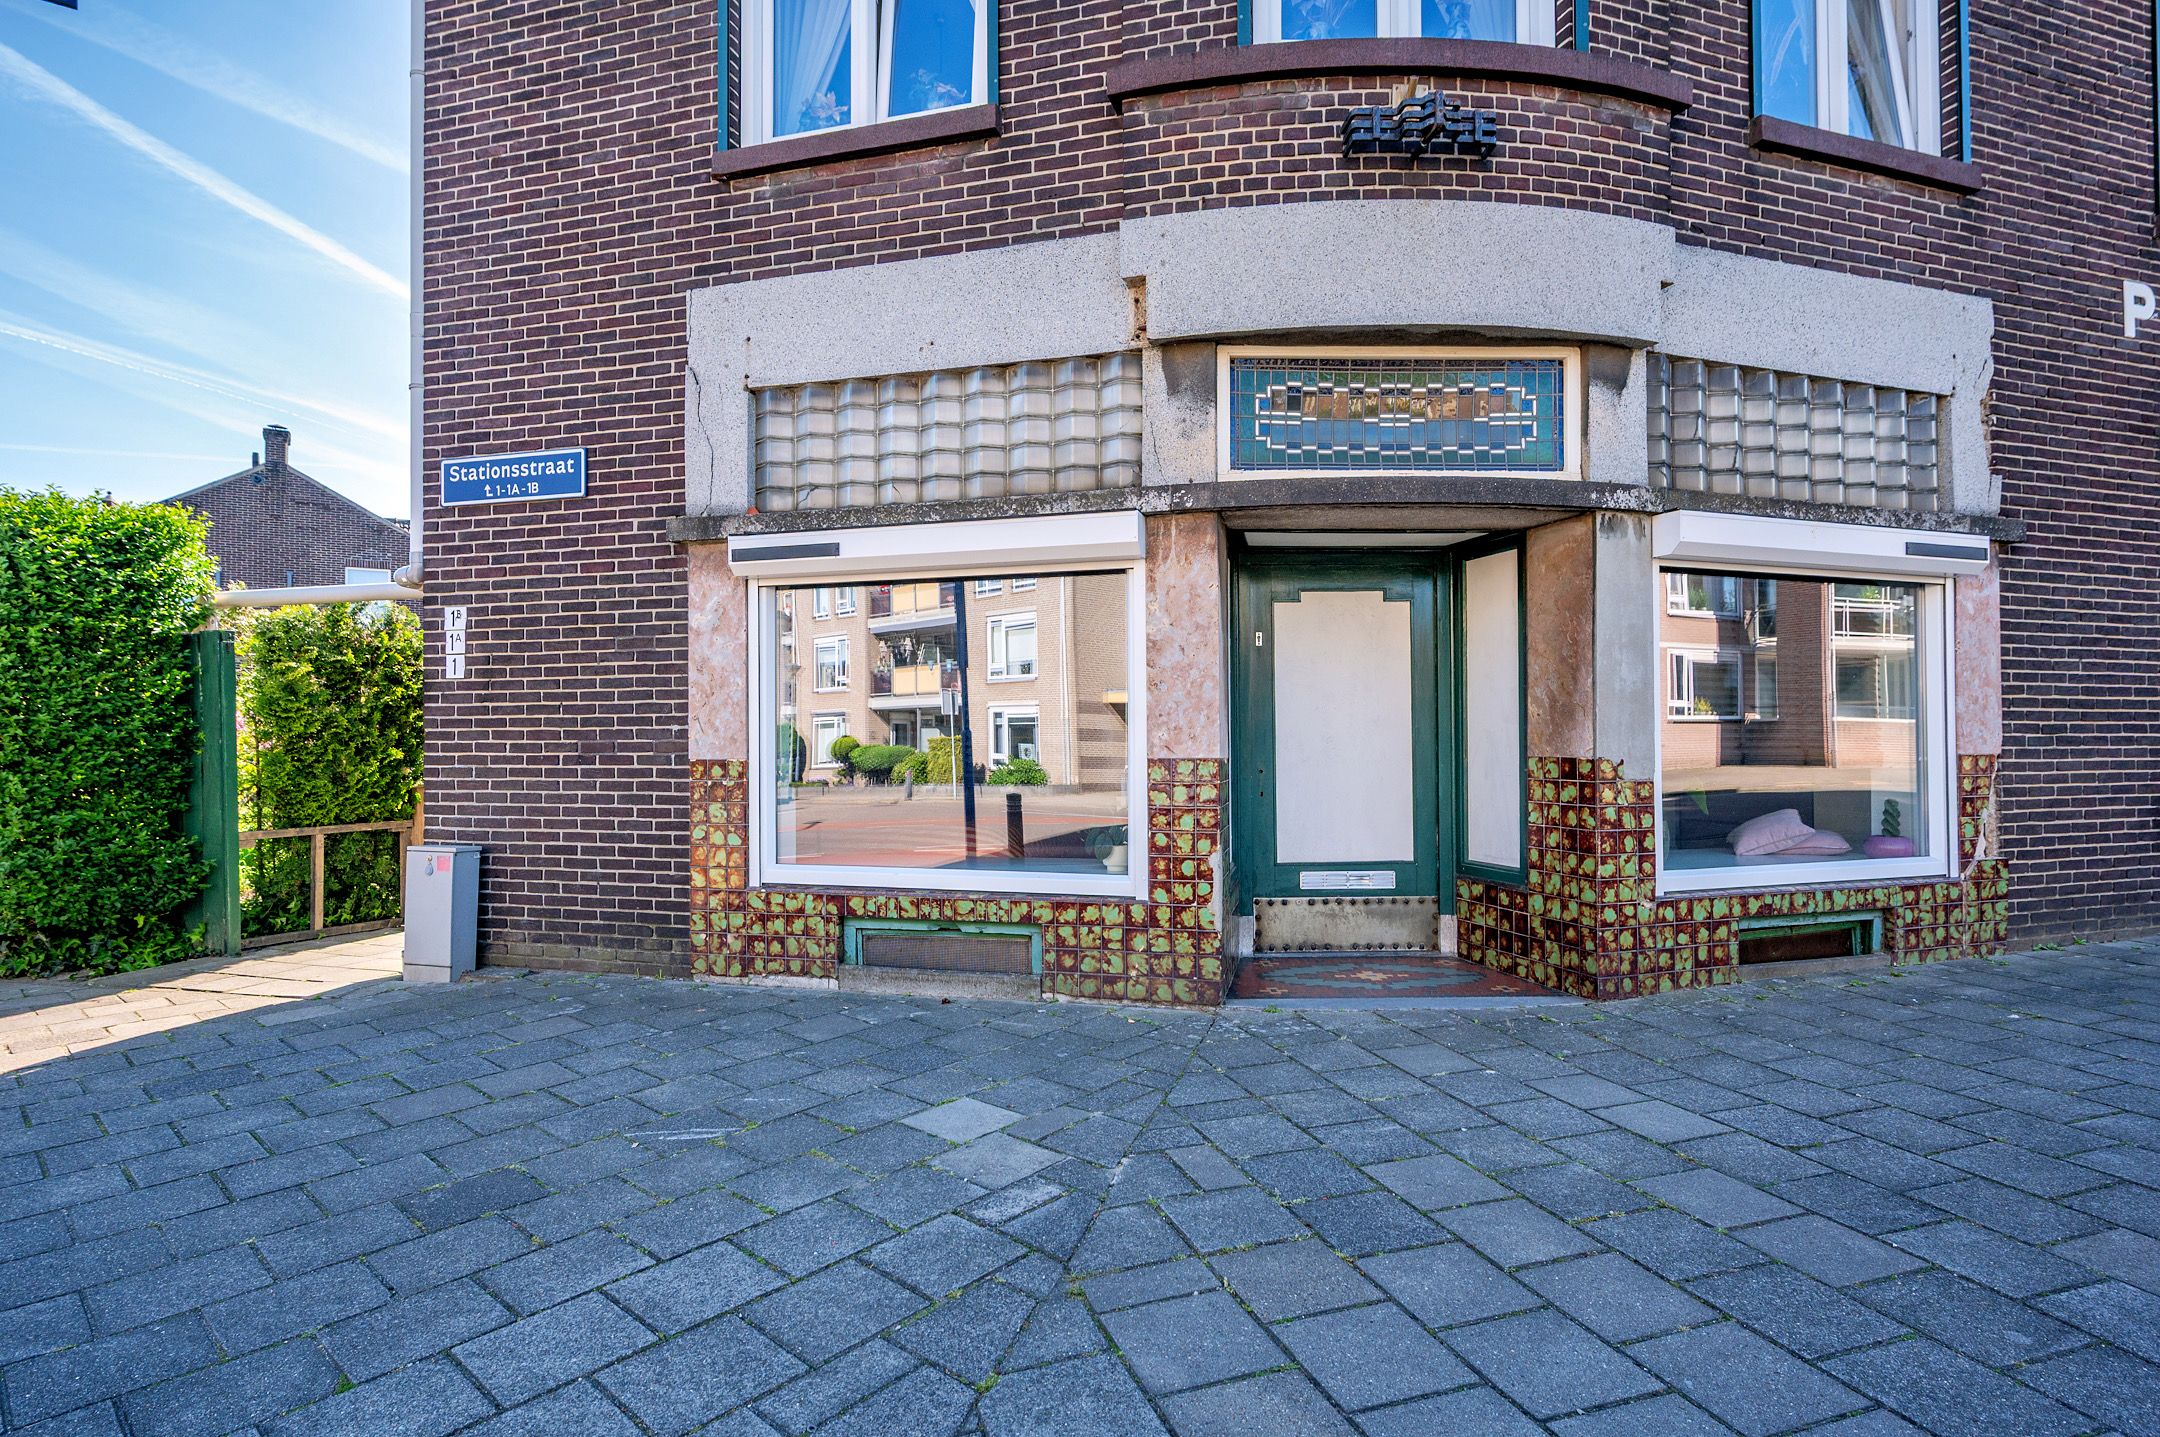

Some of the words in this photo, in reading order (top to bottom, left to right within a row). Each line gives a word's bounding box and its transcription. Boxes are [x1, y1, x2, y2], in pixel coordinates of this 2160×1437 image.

[2123, 279, 2156, 338] P
[449, 457, 575, 482] Stationsstraat
[450, 633, 462, 651] 1A
[452, 657, 457, 676] 1
